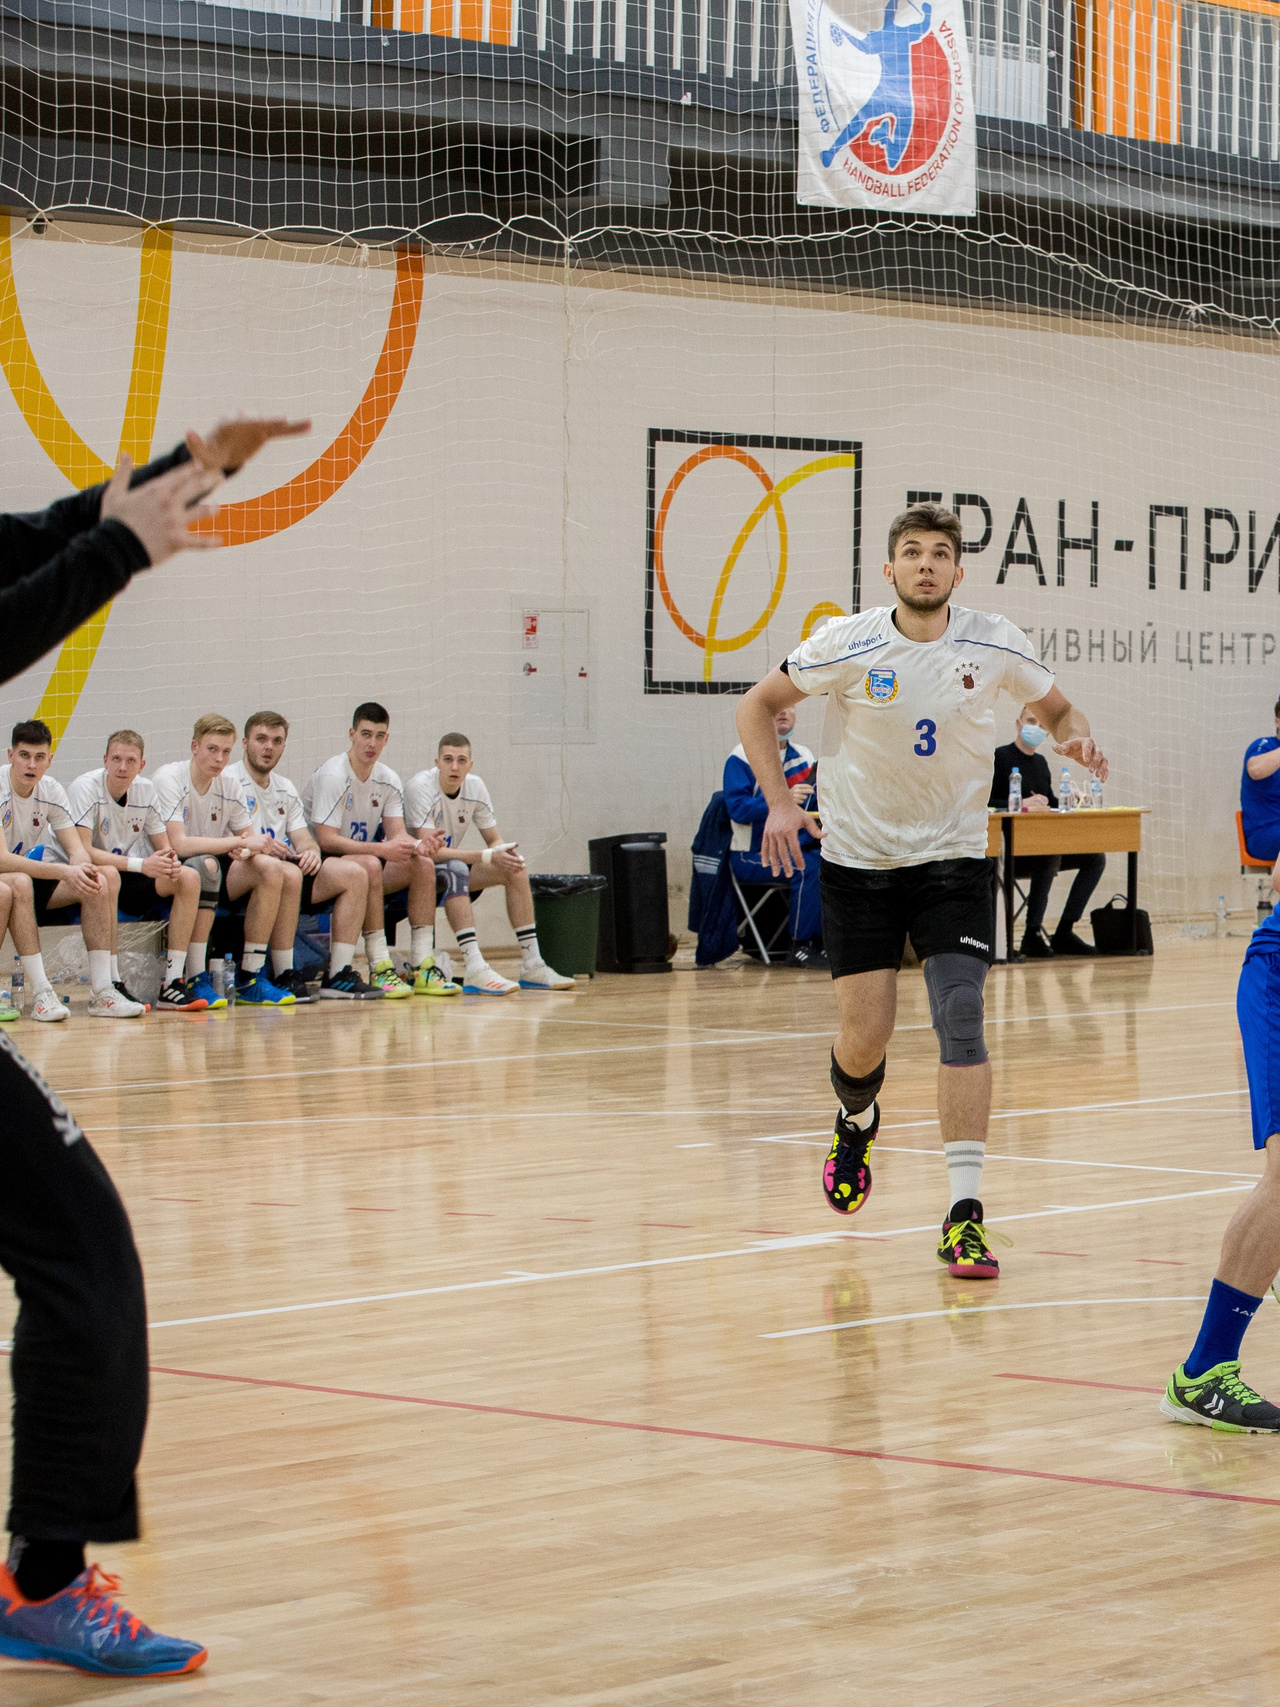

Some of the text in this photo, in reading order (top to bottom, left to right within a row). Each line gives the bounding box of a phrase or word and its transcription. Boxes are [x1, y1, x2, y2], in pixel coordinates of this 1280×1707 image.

[843, 20, 965, 198] HANDBALL FEDERATION OF RUSSIA
[848, 633, 882, 650] uhlsport
[1175, 631, 1276, 671] ЦЕНТР
[913, 719, 937, 757] 3
[350, 821, 367, 842] 25
[960, 935, 989, 952] uhlsport
